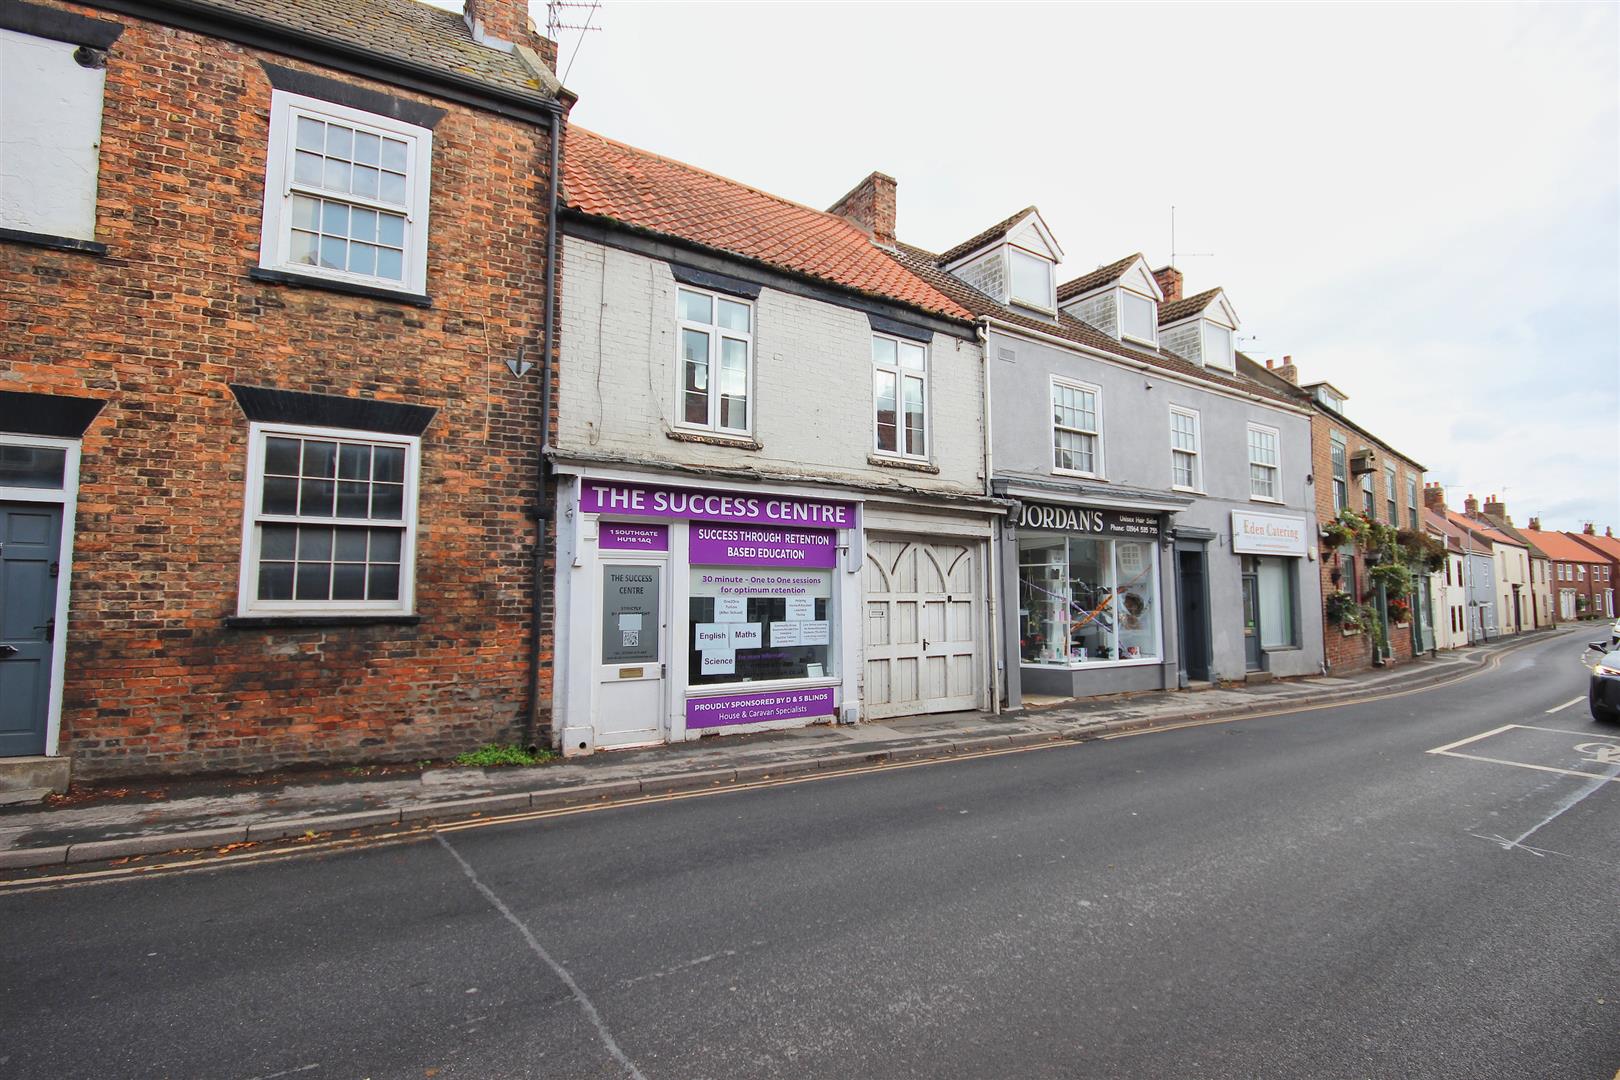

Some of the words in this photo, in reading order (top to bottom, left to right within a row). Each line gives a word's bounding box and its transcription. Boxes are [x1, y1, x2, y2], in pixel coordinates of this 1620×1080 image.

[592, 486, 645, 510] THE
[653, 491, 759, 517] SUCCESS
[766, 500, 846, 523] CENTRE
[1020, 505, 1103, 532] JORDAN'S
[615, 529, 658, 537] SOUTHGATE
[1243, 519, 1264, 535] Eden
[1266, 522, 1299, 542] Catering
[698, 528, 738, 541] SUCCESS
[740, 531, 782, 543] THROUGH
[785, 533, 829, 545] RETENTION
[727, 546, 756, 558] BASED
[758, 548, 805, 559] EDUCATION
[610, 574, 623, 582] THE
[624, 574, 653, 582] SUCCESS
[702, 575, 713, 583] 30
[714, 575, 743, 583] minute
[792, 576, 821, 584] sessions
[619, 586, 644, 595] CENTRE
[734, 586, 770, 595] optimum
[699, 632, 726, 641] English
[735, 630, 757, 639] Maths
[704, 657, 733, 665] Science
[694, 701, 730, 712] PROUDLY
[731, 698, 775, 709] SPONSORED
[804, 693, 828, 702] BLINDS
[718, 712, 740, 720] House
[749, 709, 774, 718] Caravan
[775, 704, 808, 715] Specialists
